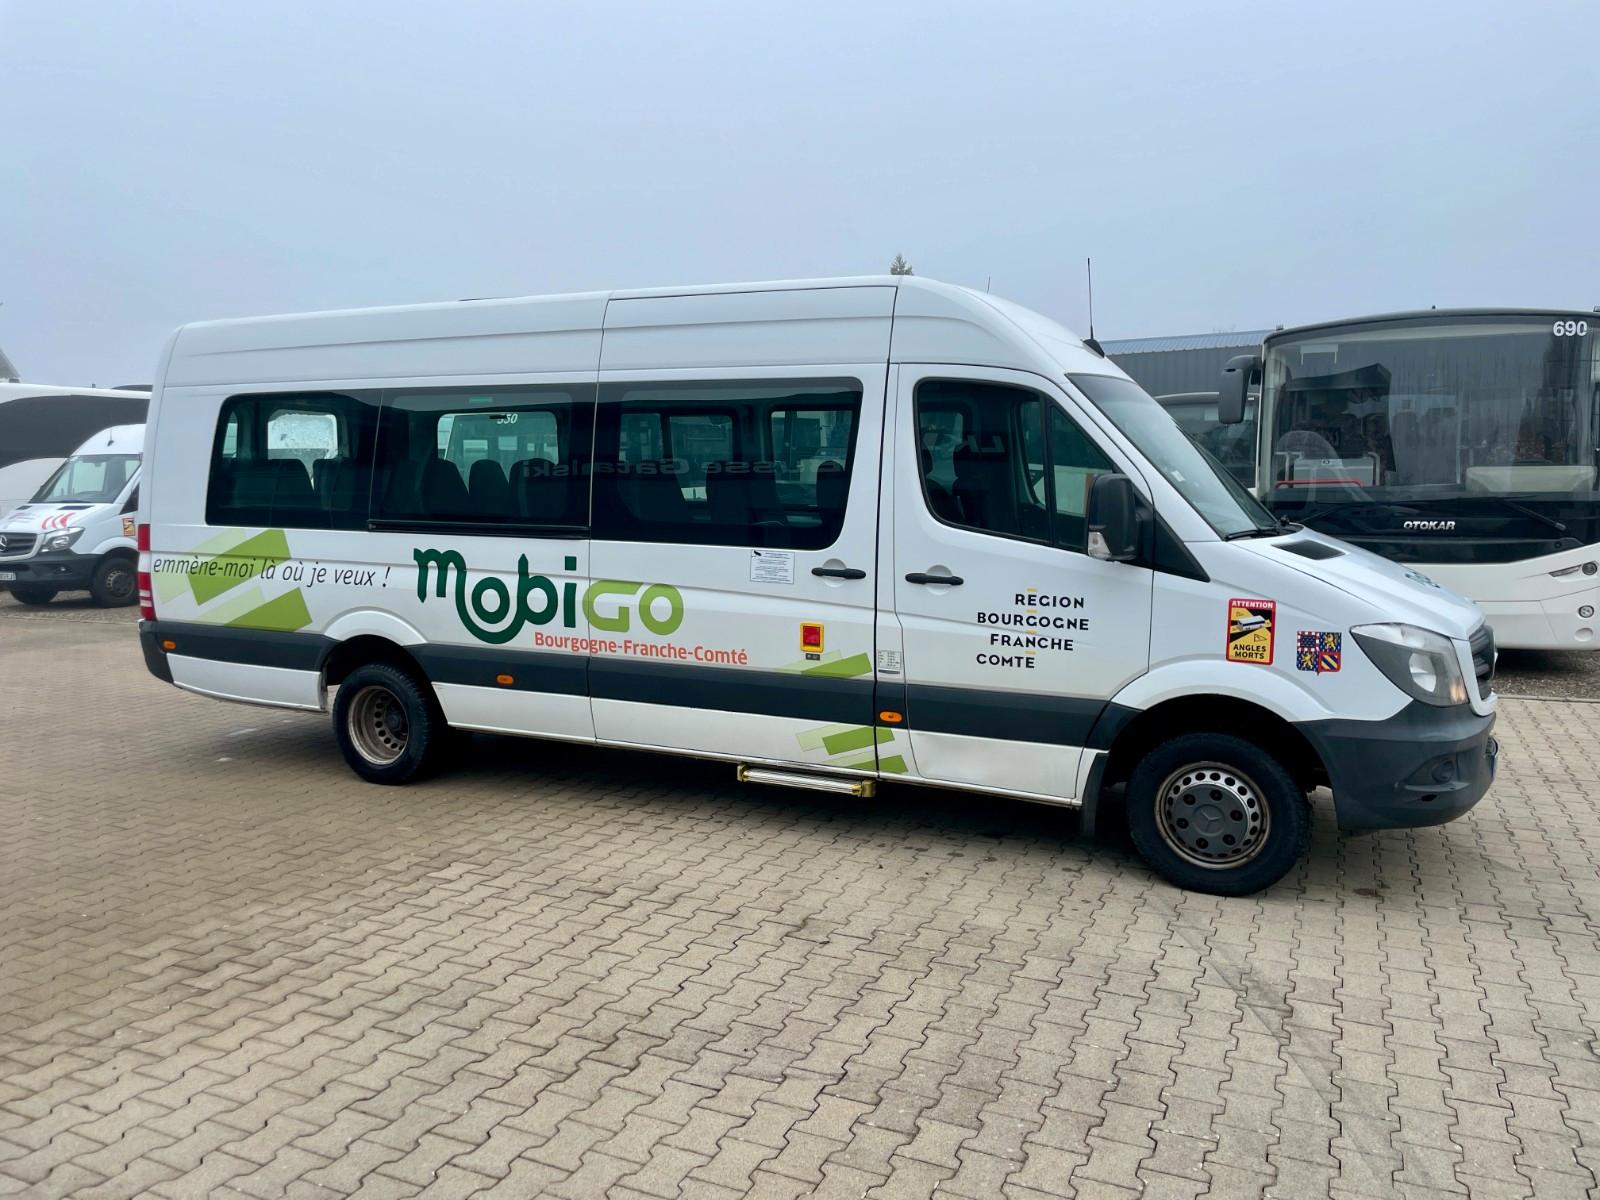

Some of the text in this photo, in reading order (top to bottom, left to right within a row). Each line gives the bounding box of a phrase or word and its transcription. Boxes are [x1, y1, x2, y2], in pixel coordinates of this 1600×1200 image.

[1553, 320, 1588, 337] 690
[1403, 520, 1456, 530] OTOKAR
[153, 555, 257, 578] emmène-moi
[260, 558, 275, 580] là
[282, 561, 304, 582] où
[306, 562, 327, 588] je
[334, 568, 376, 587] veux
[1231, 600, 1273, 609] ATTENTION
[977, 612, 1089, 631] BOURGOGNE
[535, 632, 748, 665] Bourgogne-Franche-Comté
[990, 633, 1074, 651] FRANCHE
[1233, 643, 1266, 652] ANGLES
[1234, 651, 1265, 660] MORTS
